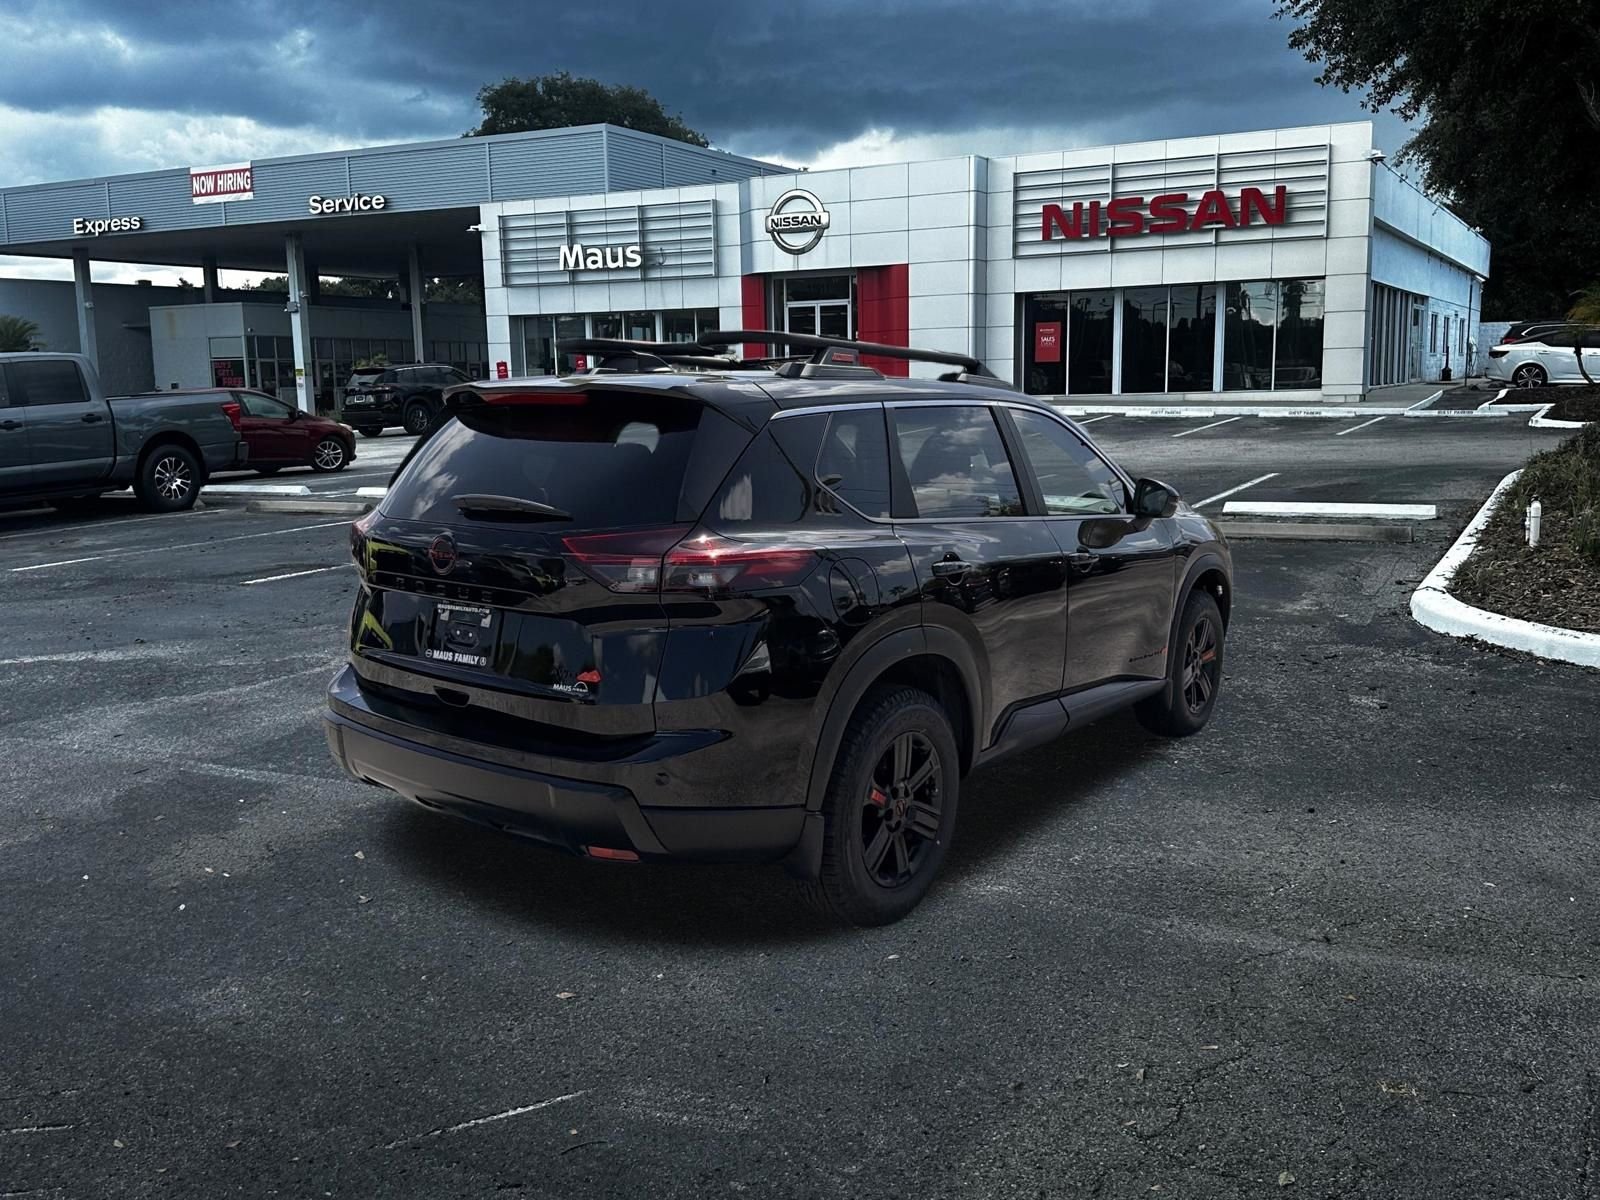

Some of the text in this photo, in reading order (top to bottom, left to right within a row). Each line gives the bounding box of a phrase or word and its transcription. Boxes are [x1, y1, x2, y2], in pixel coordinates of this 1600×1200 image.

[192, 171, 251, 195] NOW HIRING
[309, 193, 385, 215] Service
[1041, 185, 1287, 241] NISSAN
[73, 215, 141, 237] Express
[770, 214, 822, 229] NISSAN
[559, 243, 642, 271] Maus
[223, 377, 244, 386] FREE
[433, 649, 480, 665] MAUS FAMILY
[553, 683, 572, 692] MAUS
